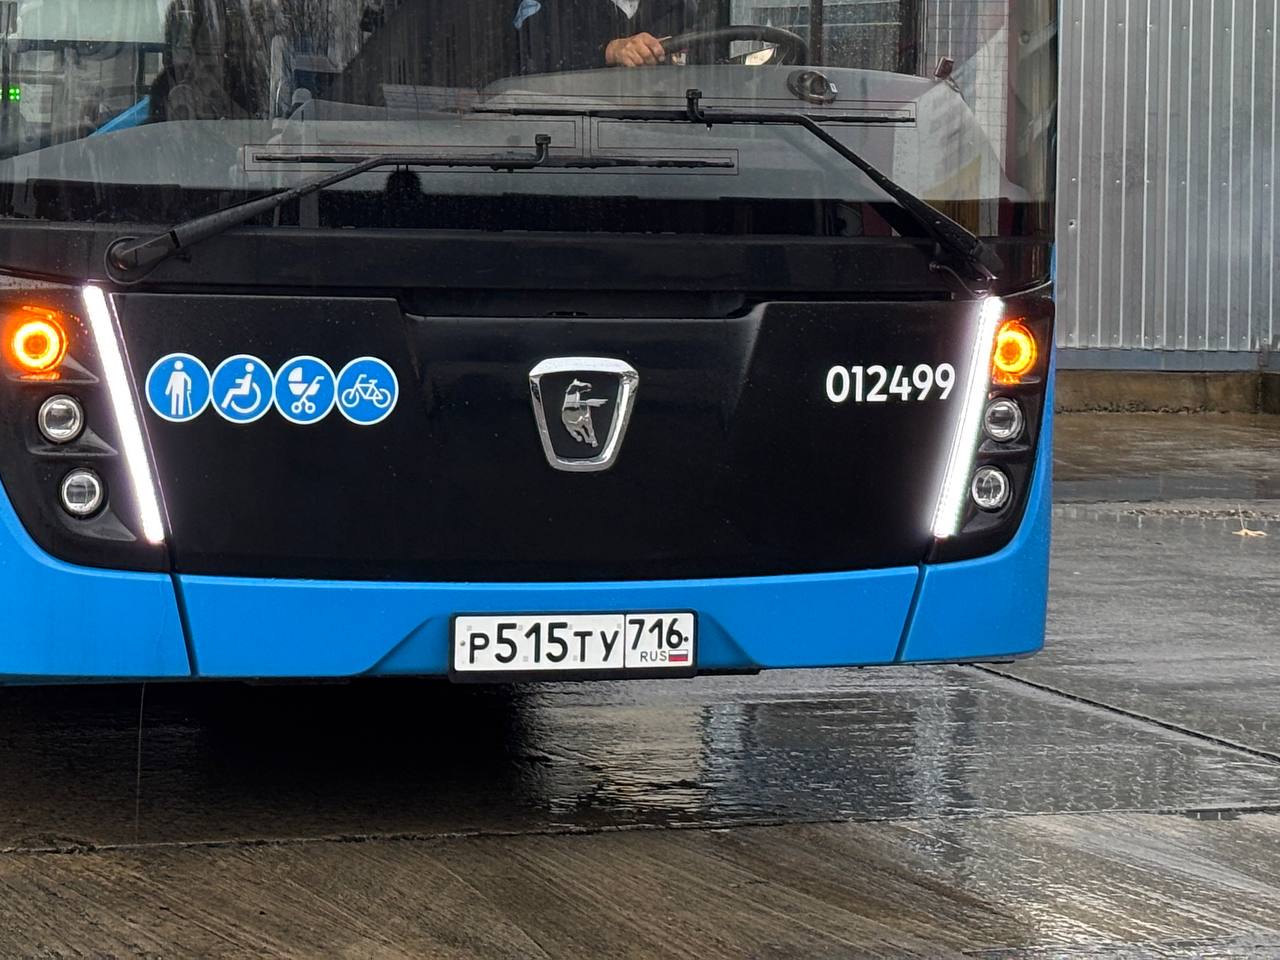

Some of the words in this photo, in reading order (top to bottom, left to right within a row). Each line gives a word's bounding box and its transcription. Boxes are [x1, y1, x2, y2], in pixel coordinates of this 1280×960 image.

[825, 362, 956, 403] 012499
[628, 618, 684, 650] 716
[640, 650, 668, 662] RUS
